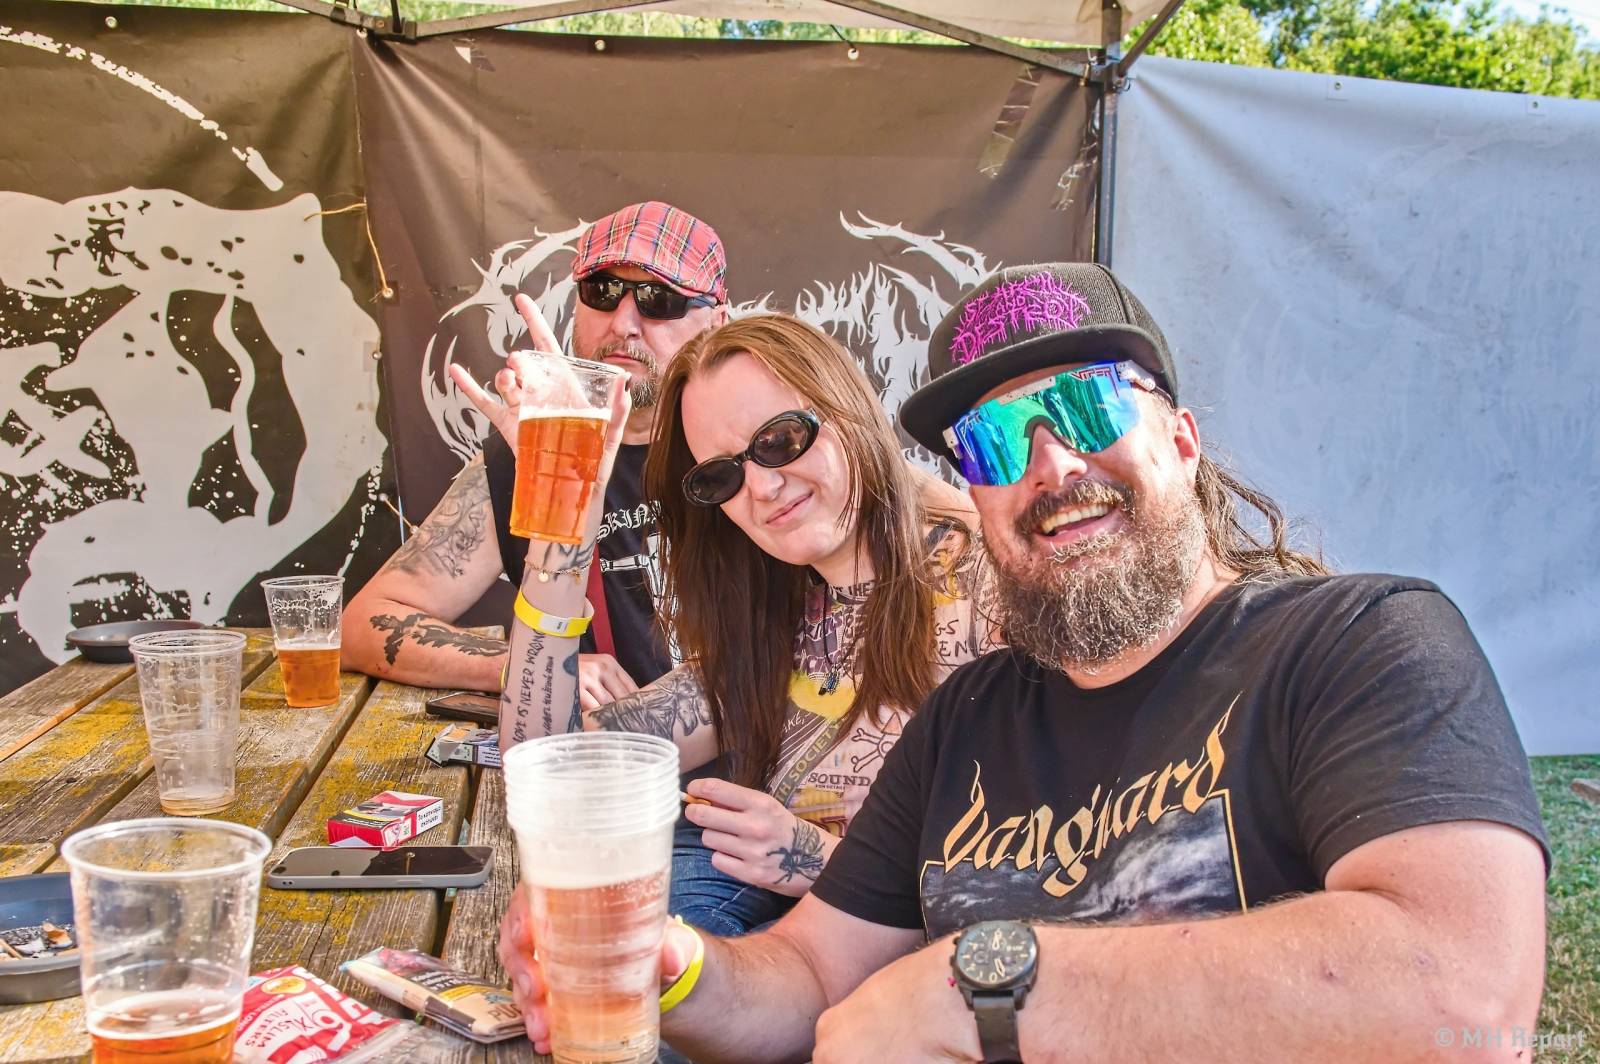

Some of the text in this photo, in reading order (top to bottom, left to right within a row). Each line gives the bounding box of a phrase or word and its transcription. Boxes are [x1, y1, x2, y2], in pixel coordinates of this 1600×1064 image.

[519, 667, 536, 706] NEVER
[517, 706, 529, 719] IS
[788, 720, 841, 781] SOCIETY
[807, 772, 872, 788] SOUND
